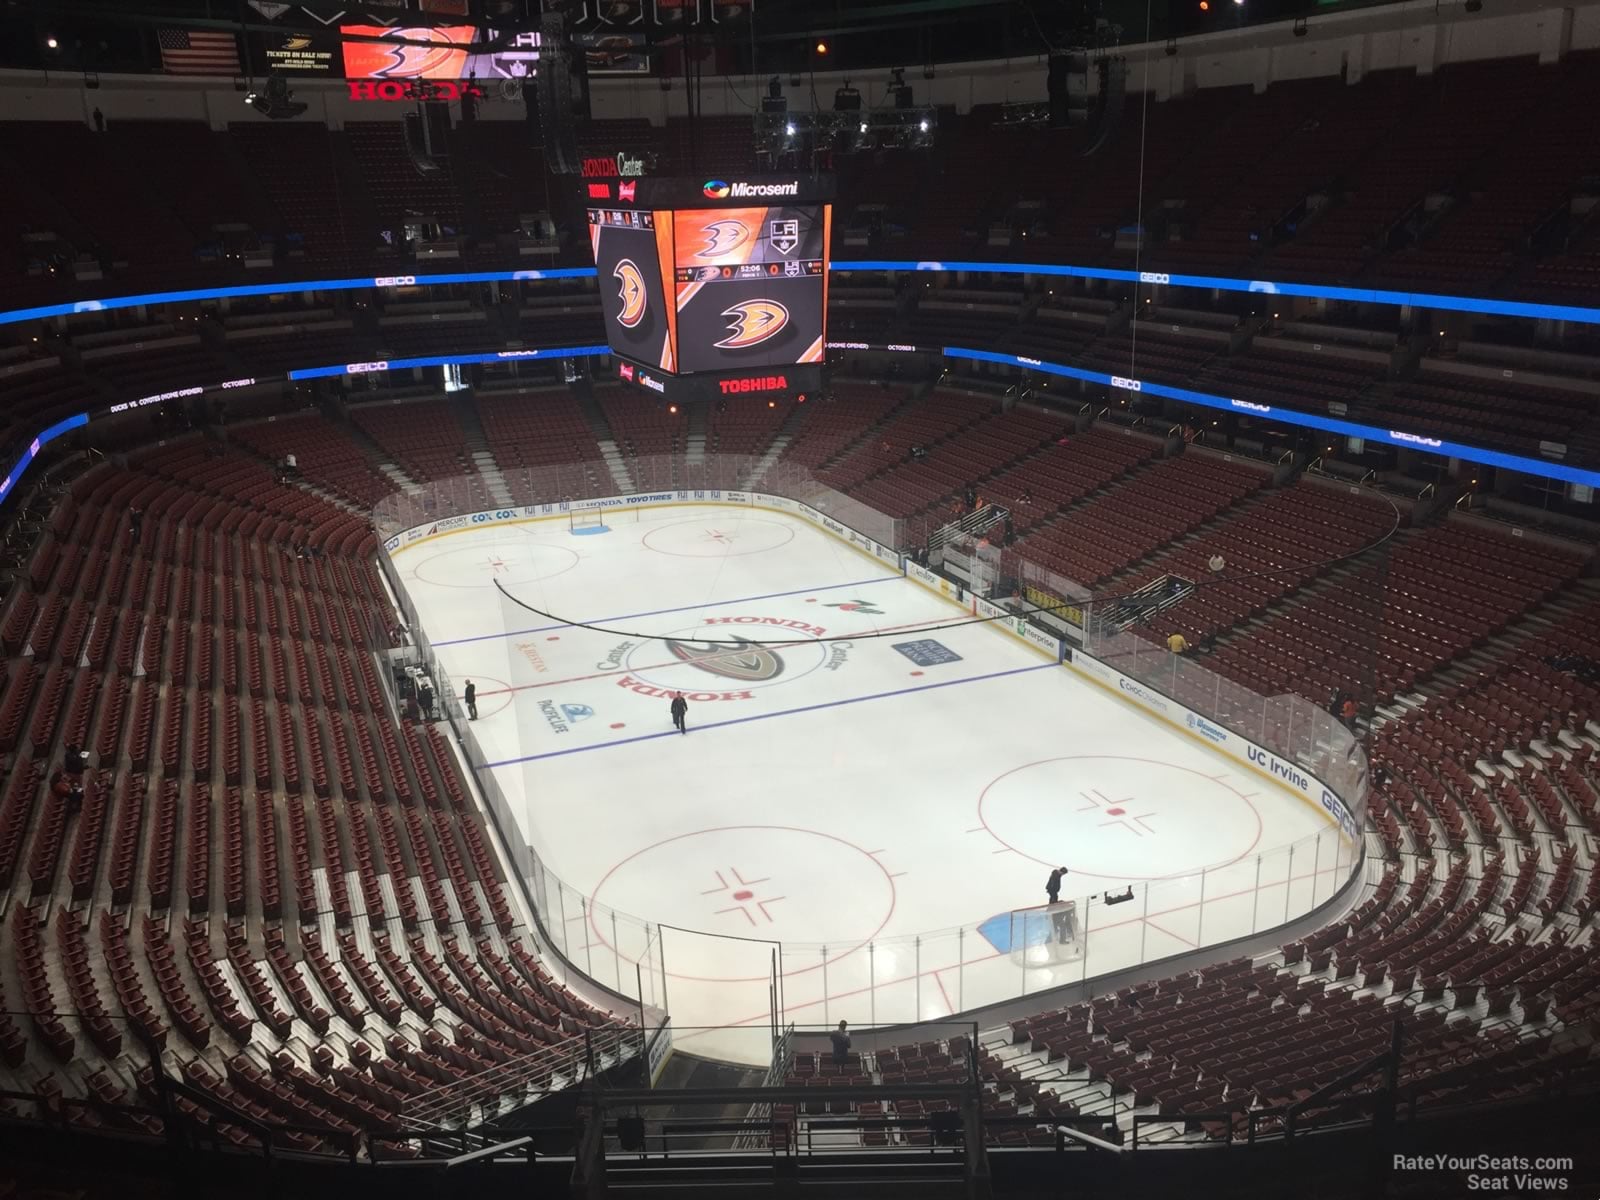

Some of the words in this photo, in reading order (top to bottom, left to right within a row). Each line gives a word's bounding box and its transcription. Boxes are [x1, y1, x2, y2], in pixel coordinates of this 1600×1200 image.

[617, 151, 643, 177] Center
[731, 181, 798, 198] Microsemi
[375, 275, 416, 287] GEICO
[1140, 272, 1169, 284] GEICO
[346, 361, 388, 373] GEICO
[222, 379, 250, 389] OCTOBER
[719, 376, 788, 394] TOSHIBA
[1111, 375, 1141, 391] GEICO
[110, 404, 128, 413] DUCKS
[471, 514, 492, 523] COX
[496, 510, 517, 520] COX
[703, 616, 828, 636] HONDA
[597, 640, 635, 671] Center
[824, 640, 854, 672] Center
[616, 675, 756, 702] HONDA
[1247, 745, 1266, 767] UC
[1270, 758, 1309, 791] Irvine
